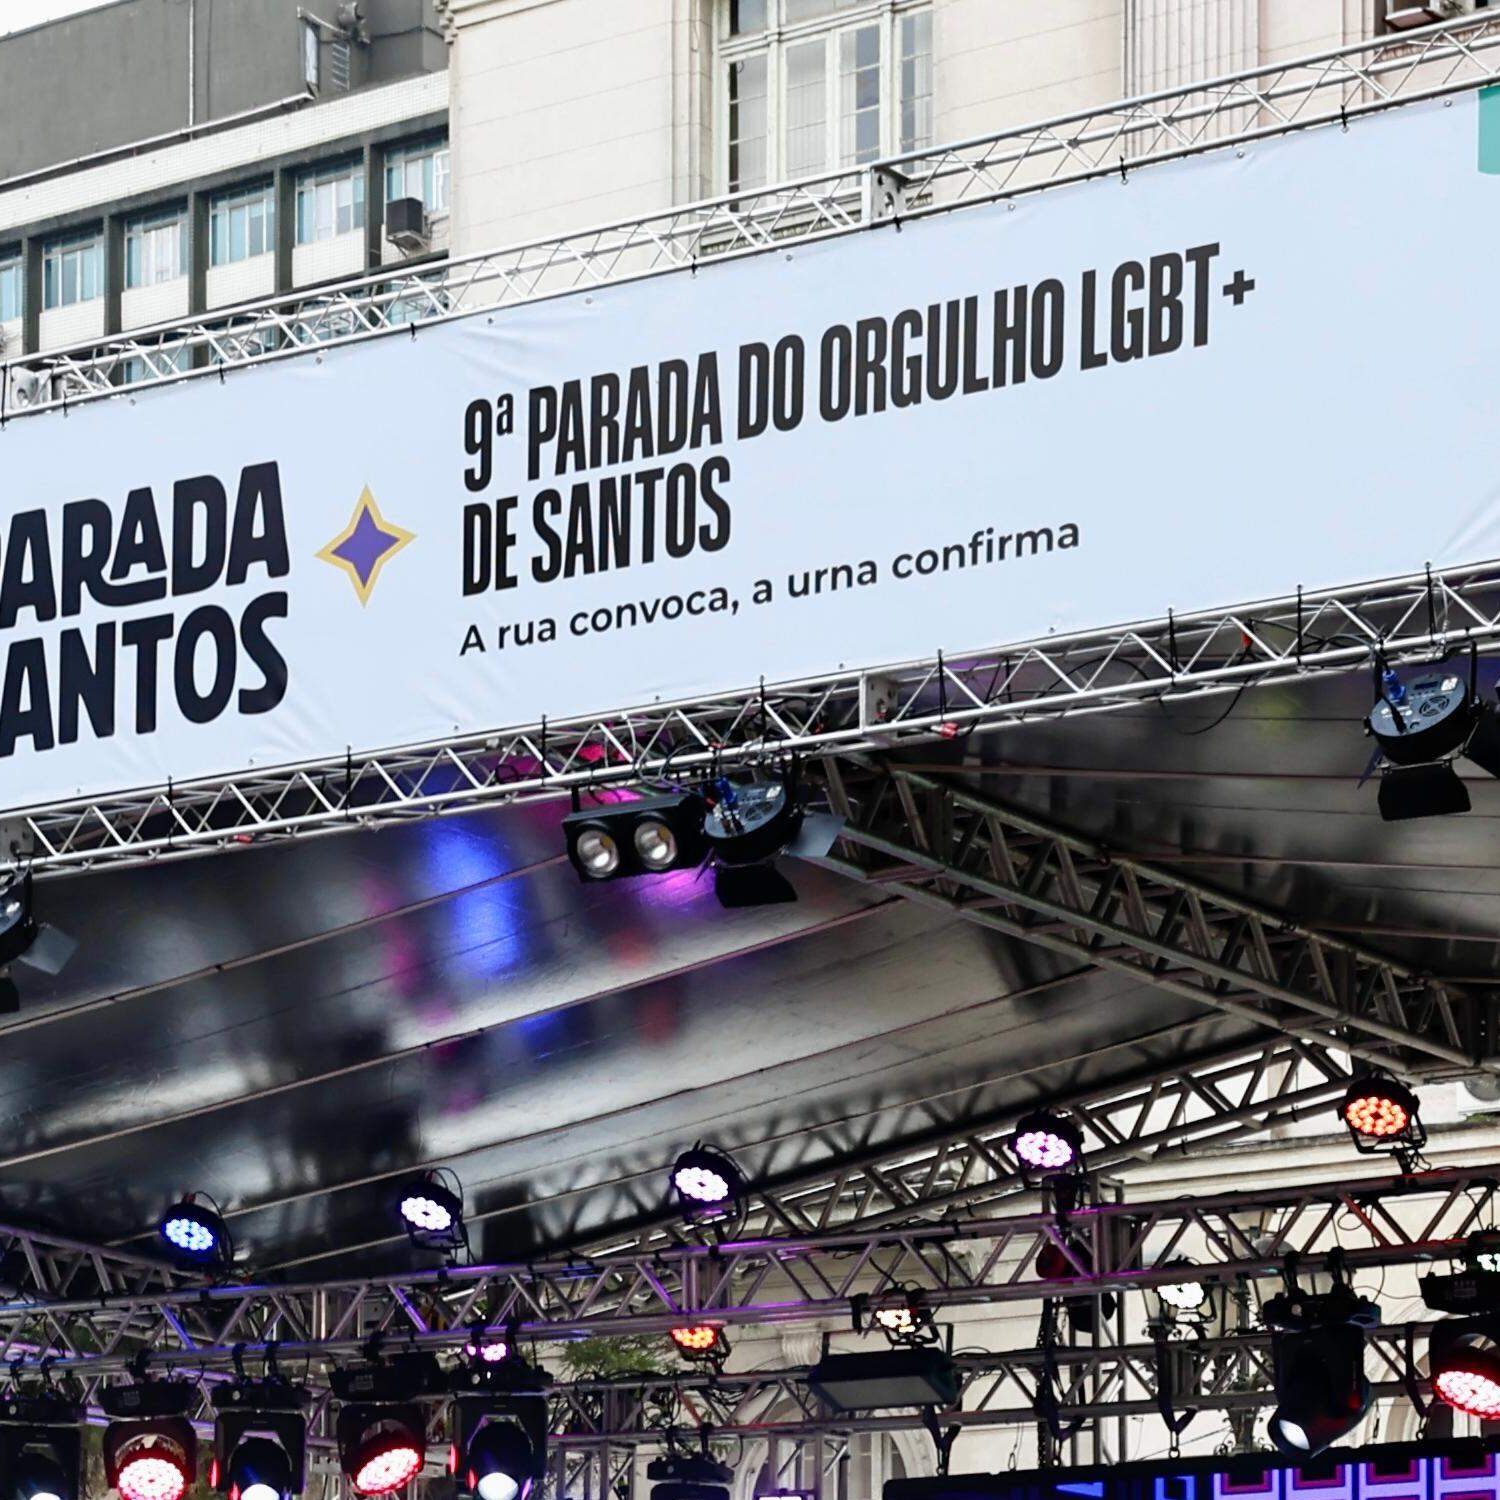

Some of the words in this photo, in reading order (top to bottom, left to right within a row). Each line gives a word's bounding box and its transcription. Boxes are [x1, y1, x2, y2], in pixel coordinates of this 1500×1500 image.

[463, 392, 514, 493] 9ª
[528, 349, 722, 479] PARADA
[737, 333, 803, 438] DO
[818, 278, 1065, 423] ORGULHO
[1081, 243, 1256, 371] LGBT+
[460, 625, 486, 656] A
[497, 616, 556, 650] rua
[569, 589, 740, 635] convoca,
[753, 579, 773, 603] a
[787, 561, 878, 598] urna
[891, 521, 1080, 580] confirma
[463, 493, 518, 596] DE
[531, 456, 732, 584] SANTOS
